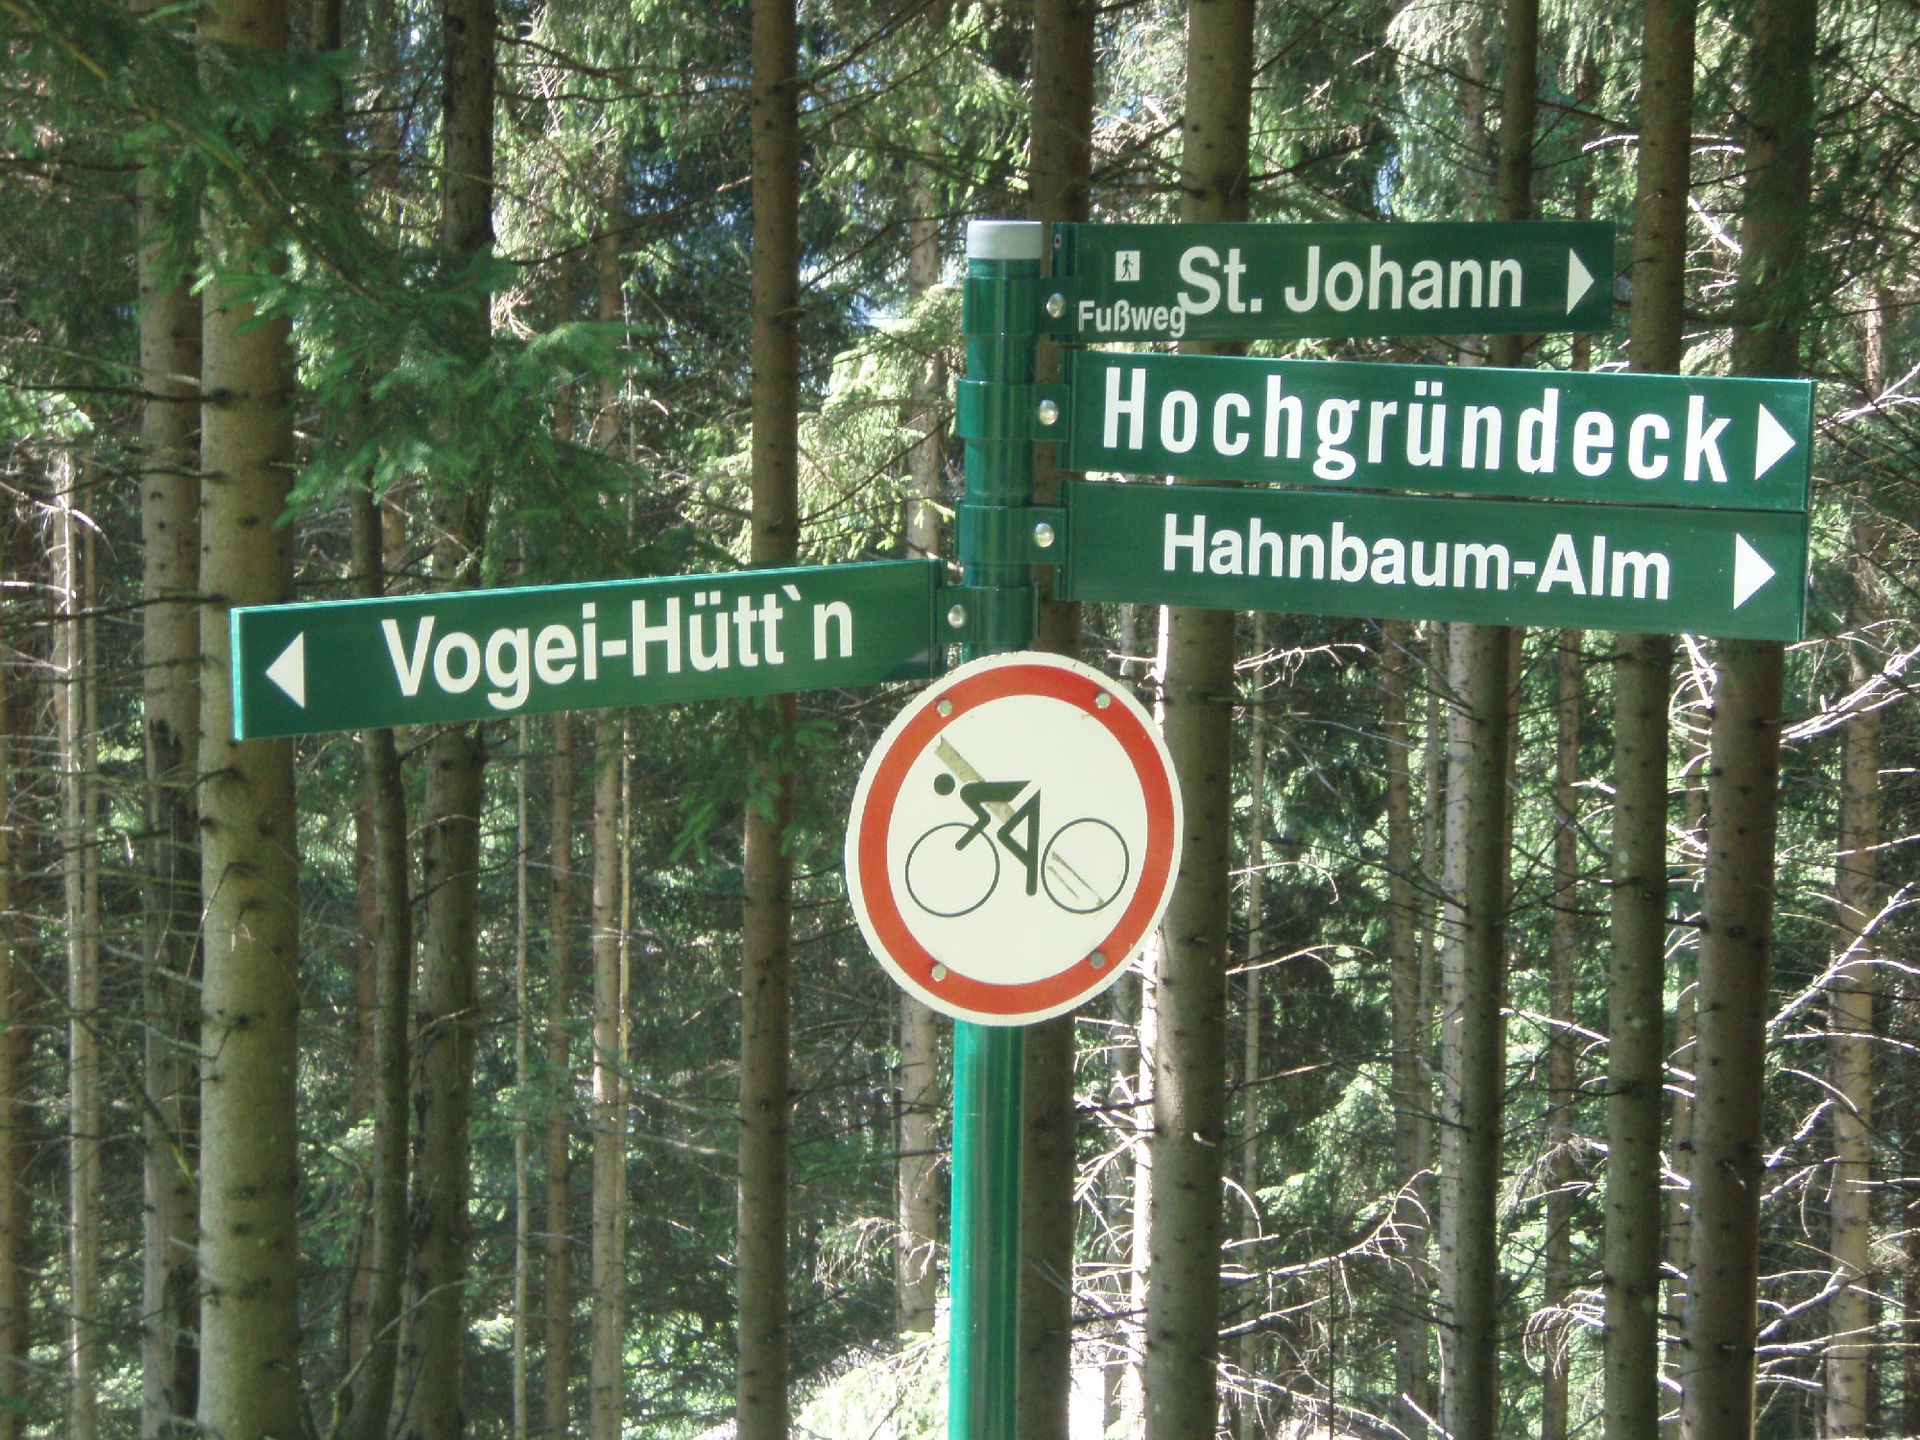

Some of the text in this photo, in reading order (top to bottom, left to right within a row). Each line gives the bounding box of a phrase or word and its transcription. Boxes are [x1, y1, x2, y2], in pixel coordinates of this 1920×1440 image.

[1078, 299, 1187, 339] Fußweg
[1177, 244, 1523, 315] St. Johann
[1102, 366, 1733, 484] Hochgründeck
[1162, 513, 1670, 601] Hahnbaum-Alm
